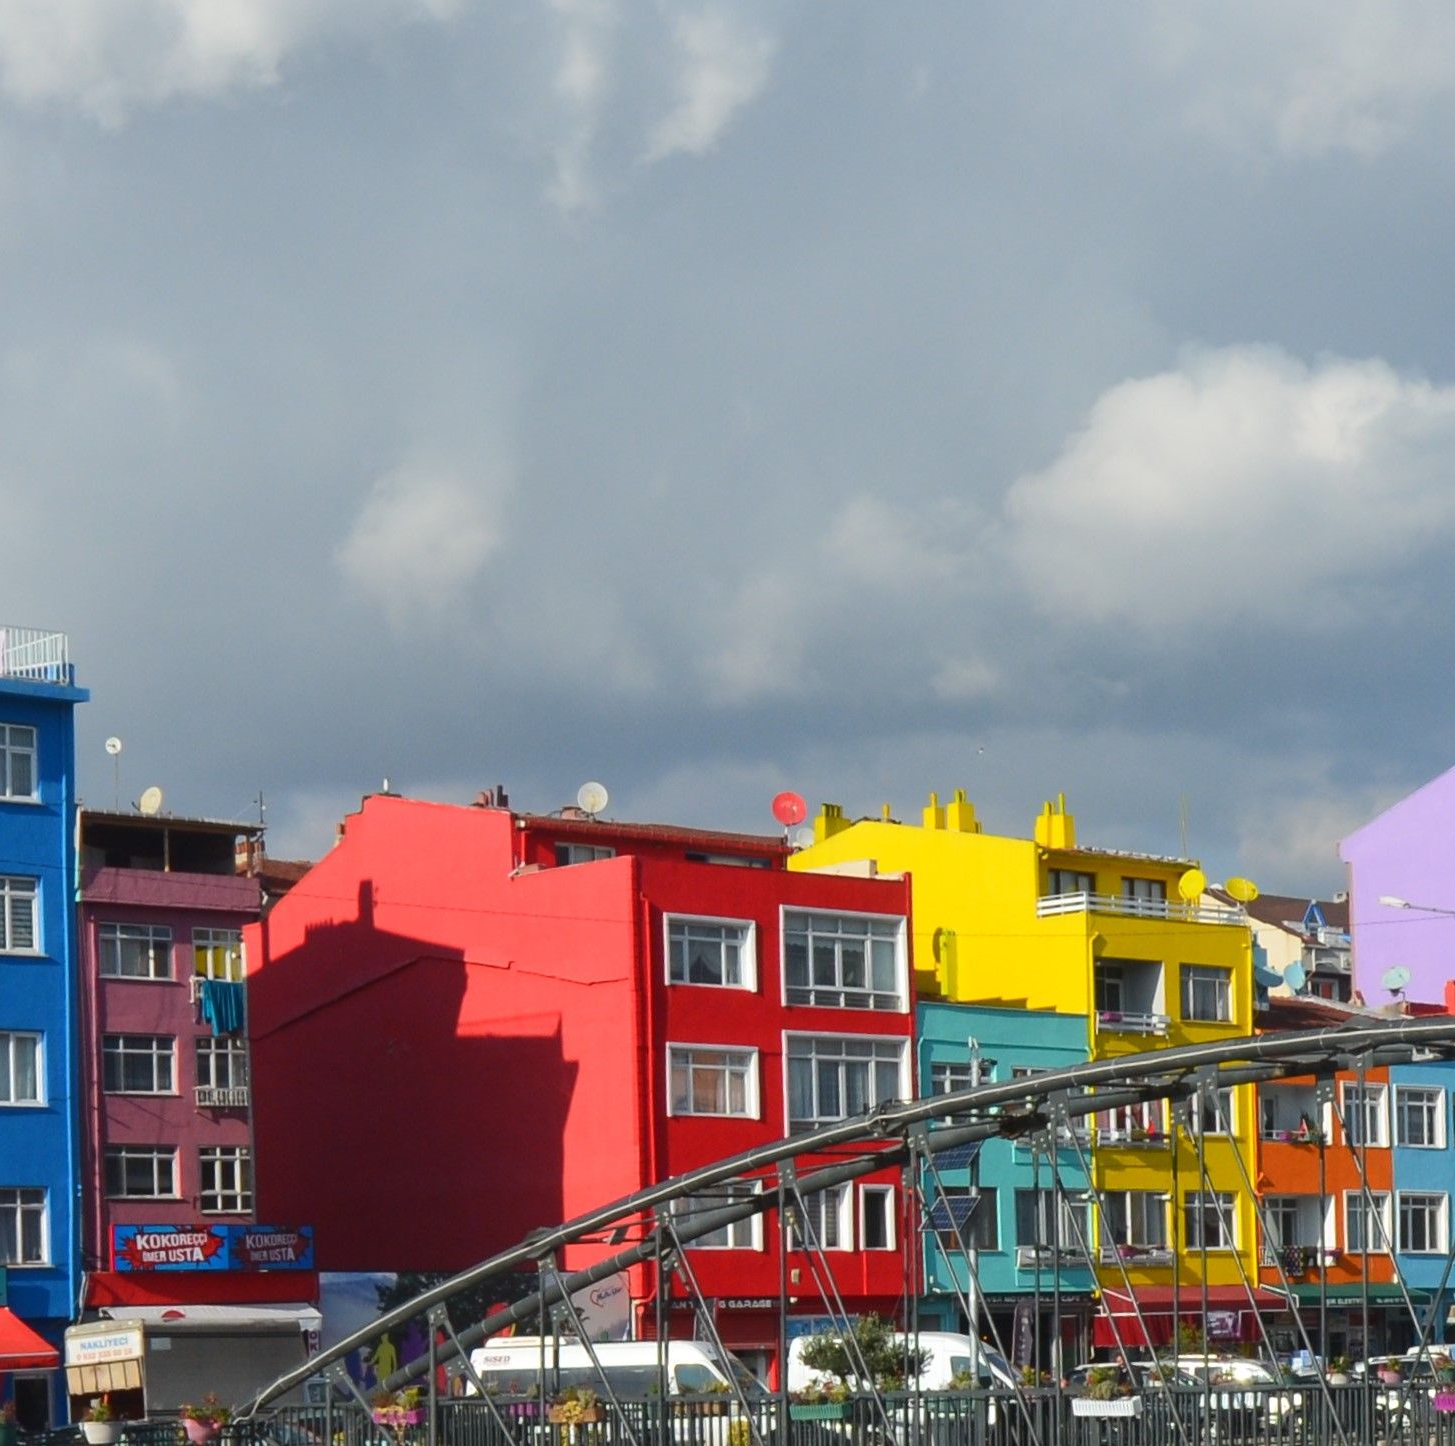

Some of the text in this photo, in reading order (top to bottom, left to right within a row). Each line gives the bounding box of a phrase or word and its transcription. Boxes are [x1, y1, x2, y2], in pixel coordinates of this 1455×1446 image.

[168, 1247, 205, 1262] USTA
[269, 1248, 295, 1261] USTA
[728, 1299, 772, 1309] GARAGE
